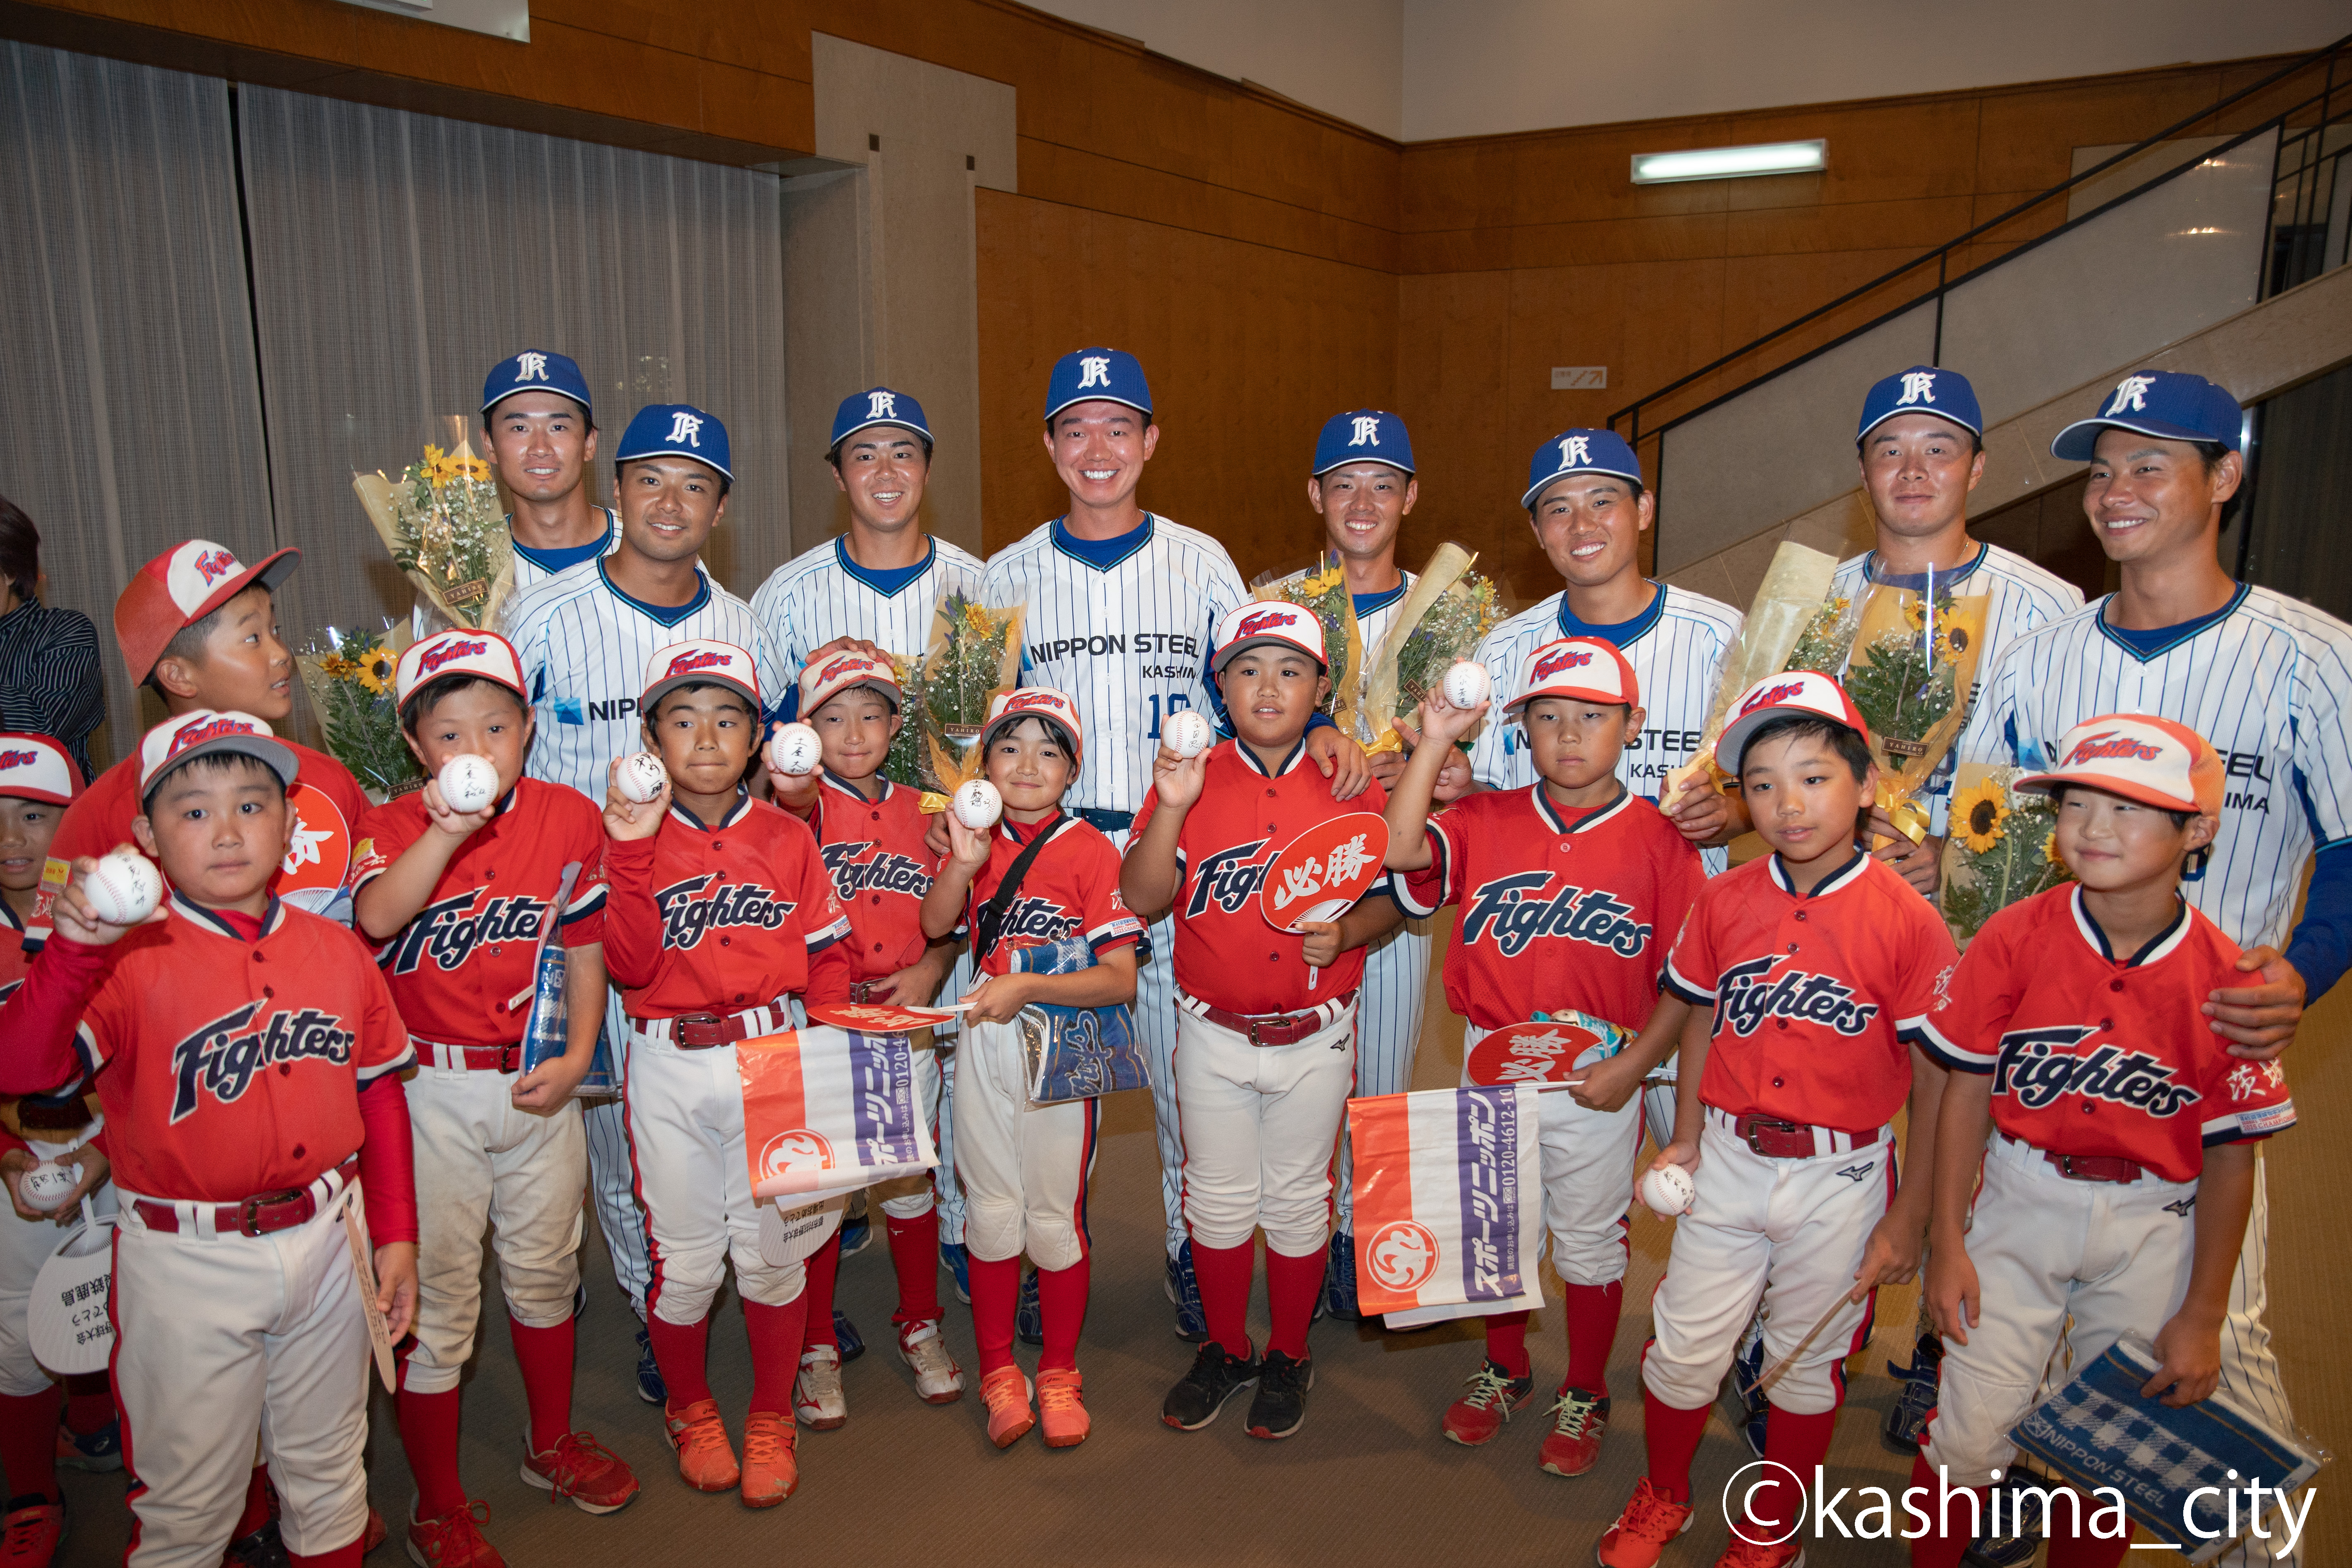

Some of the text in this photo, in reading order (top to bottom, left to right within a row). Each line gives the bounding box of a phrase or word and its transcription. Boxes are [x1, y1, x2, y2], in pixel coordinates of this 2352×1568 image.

[450, 585, 482, 598] YAHIRO
[1234, 611, 1297, 639] Fighters
[414, 638, 487, 682] Fighters
[664, 649, 733, 676] Fighters
[1031, 633, 1199, 665] NIPPON STEEL
[814, 656, 874, 691] Fighters
[1142, 666, 1197, 679] KASHIM
[1529, 649, 1593, 687] Fighters
[589, 697, 642, 722] NIP
[1004, 692, 1066, 711] Fighters
[166, 714, 254, 760] Fighters
[1624, 730, 1701, 752] STEE
[1890, 742, 1922, 752] YAHIRO
[2061, 732, 2163, 768] Fighters
[394, 783, 423, 793] YAHIRO
[1274, 833, 1377, 910] 必勝
[654, 872, 798, 951] Fighters
[1463, 870, 1652, 958] Fighters
[1712, 953, 1878, 1039] Fighters
[170, 998, 354, 1125] Fighters
[1495, 1028, 1572, 1082] 必勝
[1991, 1025, 2202, 1118] Fighters
[1468, 1090, 1503, 1297] スポーツニッポン
[783, 1216, 824, 1243] 都市対抗野球大会
[2043, 1429, 2166, 1509] NIPPON STEEL
